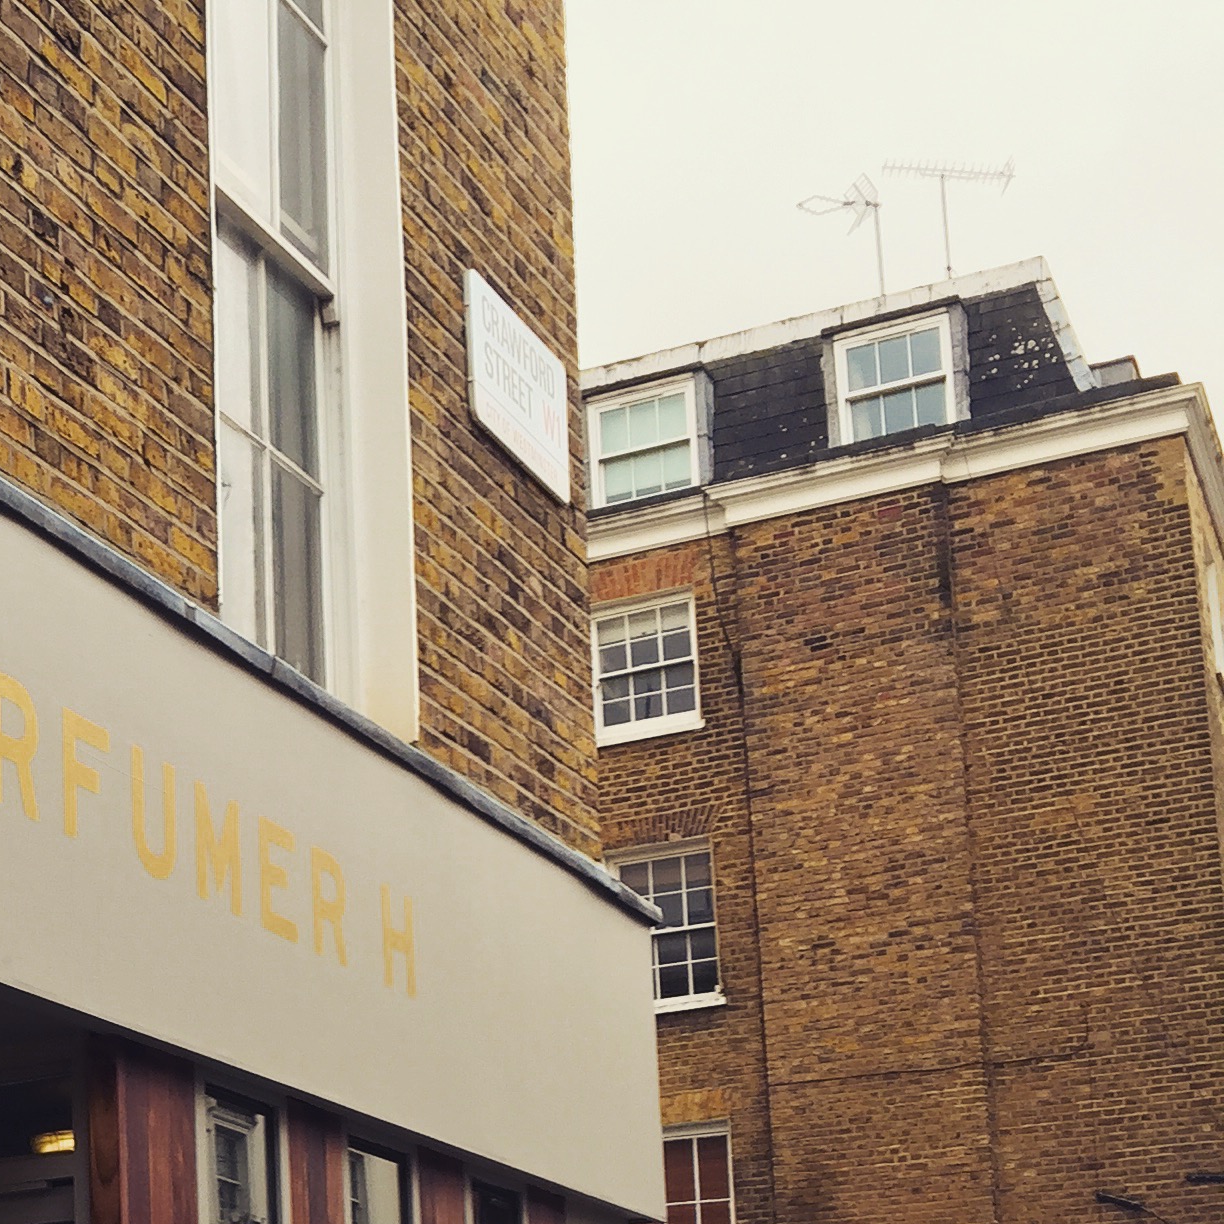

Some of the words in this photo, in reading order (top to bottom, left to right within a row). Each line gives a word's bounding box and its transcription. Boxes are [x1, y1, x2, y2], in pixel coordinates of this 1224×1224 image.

[481, 294, 555, 399] CRAWFORD
[484, 341, 533, 419] STREET
[542, 399, 561, 449] W1
[381, 883, 418, 999] H
